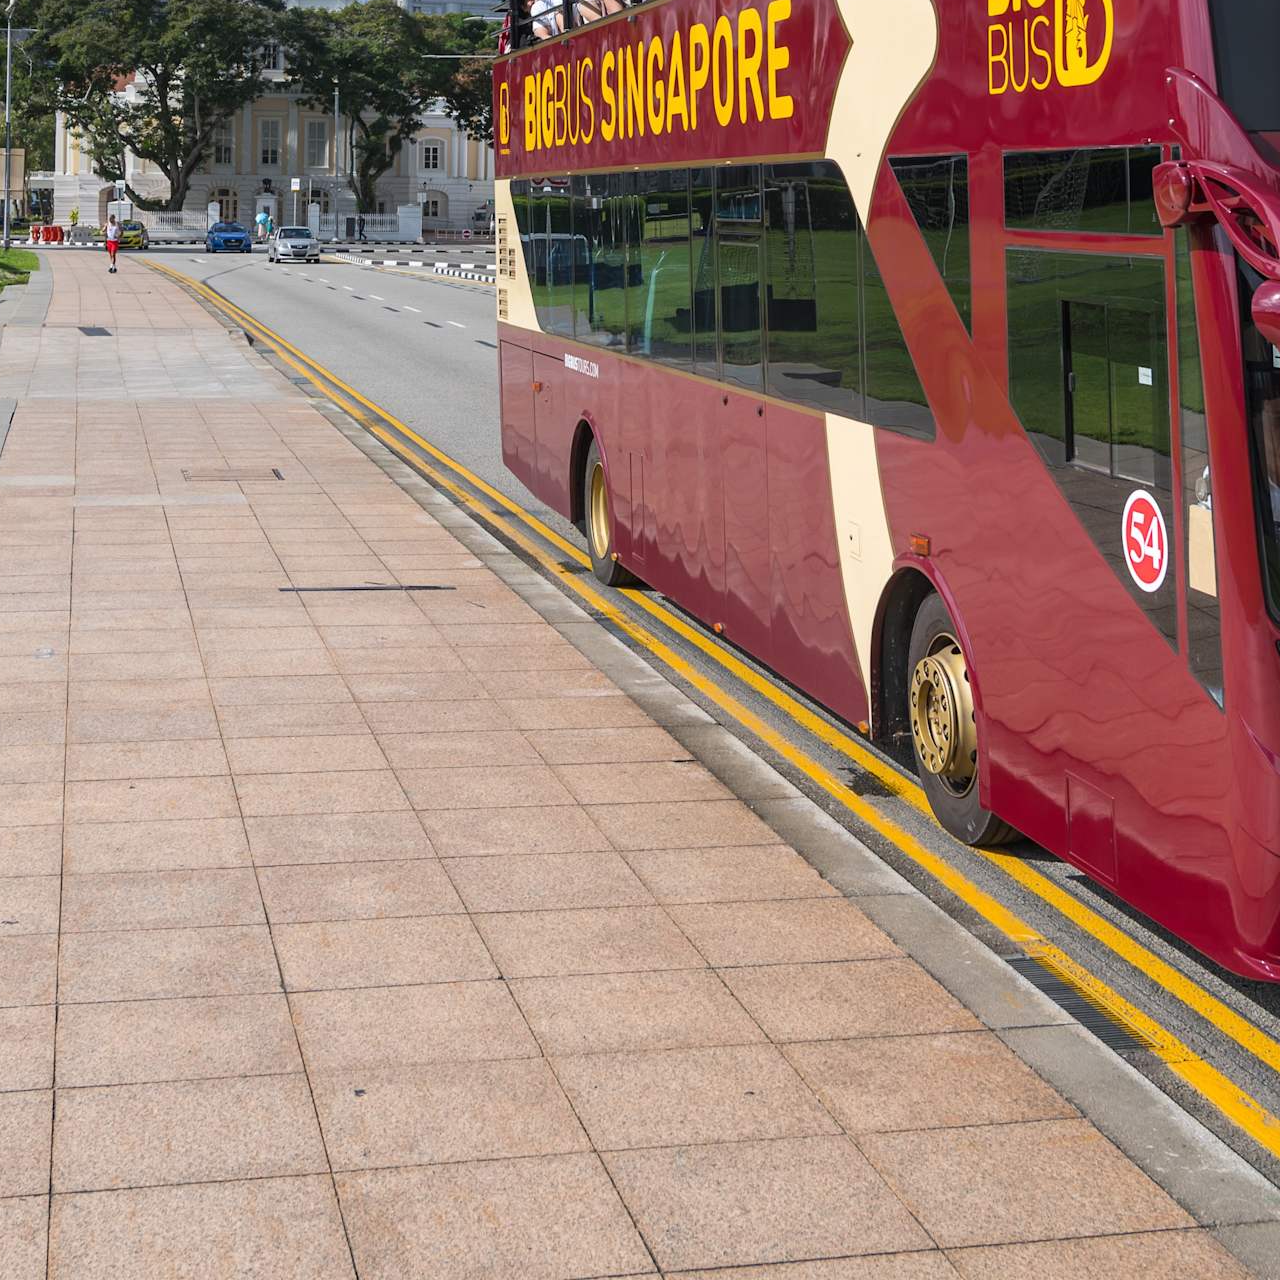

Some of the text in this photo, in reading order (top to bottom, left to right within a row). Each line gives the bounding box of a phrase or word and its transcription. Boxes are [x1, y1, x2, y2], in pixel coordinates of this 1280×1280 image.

[988, 15, 1052, 95] BUS
[525, 57, 595, 152] BIGBUS
[1130, 511, 1161, 570] 54
